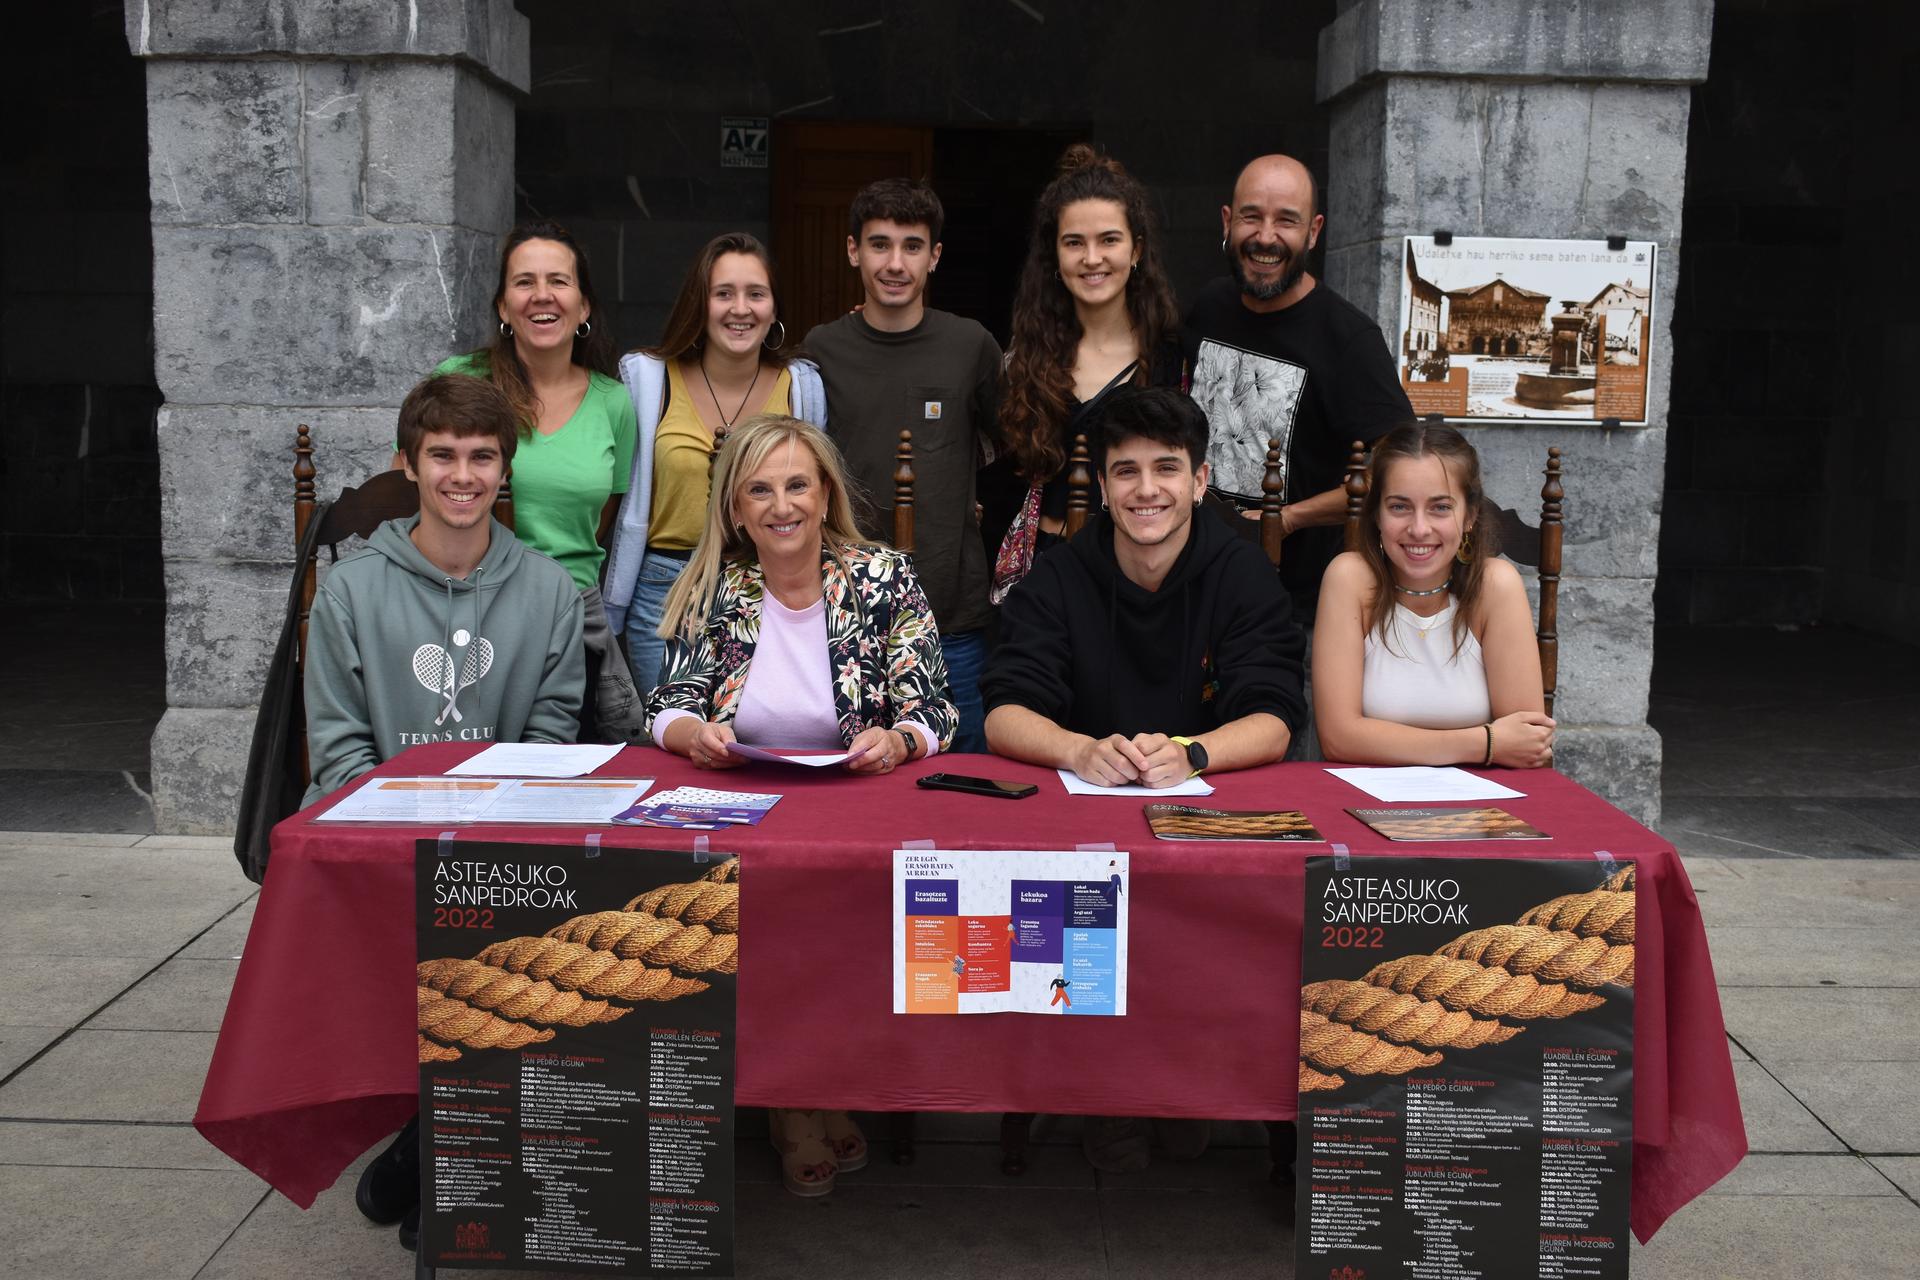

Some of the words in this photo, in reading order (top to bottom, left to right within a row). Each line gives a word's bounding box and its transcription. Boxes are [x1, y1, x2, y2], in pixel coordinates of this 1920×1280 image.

[1416, 244, 1462, 260] Udaletxe
[1466, 249, 1484, 260] hau
[1490, 250, 1524, 260] herriko
[1530, 253, 1554, 262] seme
[1559, 252, 1586, 262] baten
[1591, 252, 1611, 263] lana
[1616, 254, 1628, 263] da
[460, 726, 496, 740] CLU
[434, 861, 567, 886] ASTEASUKO
[434, 884, 578, 910] SANPEDROAK
[1323, 877, 1460, 902] ASTEASUKO
[433, 908, 494, 929] 2022
[1322, 902, 1470, 925] SANPEDROAK
[1321, 927, 1384, 948] 2022
[682, 1204, 720, 1212] MOZORRO
